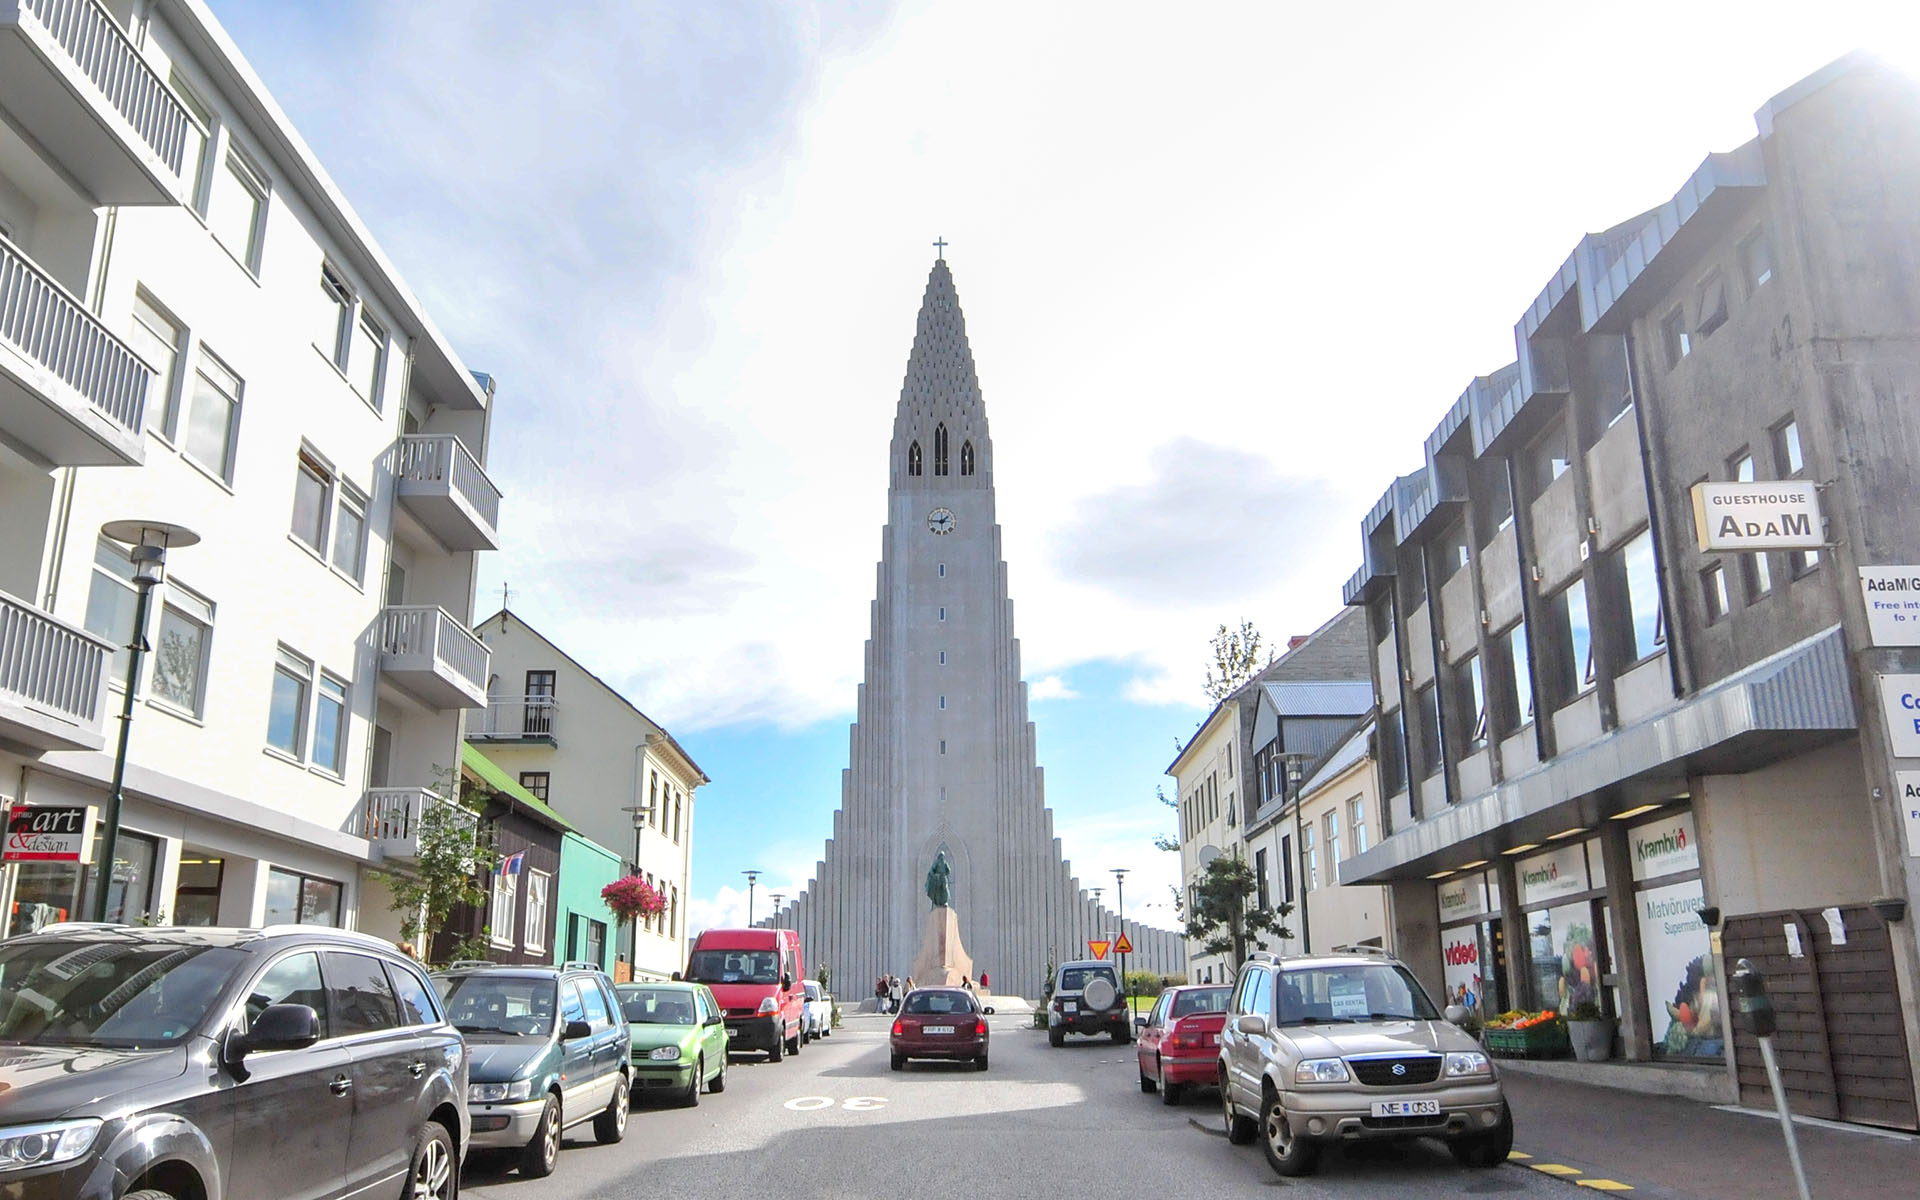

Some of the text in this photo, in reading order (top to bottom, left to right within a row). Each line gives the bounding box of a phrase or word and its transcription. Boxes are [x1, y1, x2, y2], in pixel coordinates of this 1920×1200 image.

[1713, 494, 1806, 505] GUESTHOUSE
[1874, 601, 1920, 609] Free int
[32, 808, 81, 832] art
[28, 835, 69, 853] design
[1636, 827, 1687, 862] Krambúð
[1445, 940, 1477, 966] video
[1381, 1102, 1436, 1114] NE 033
